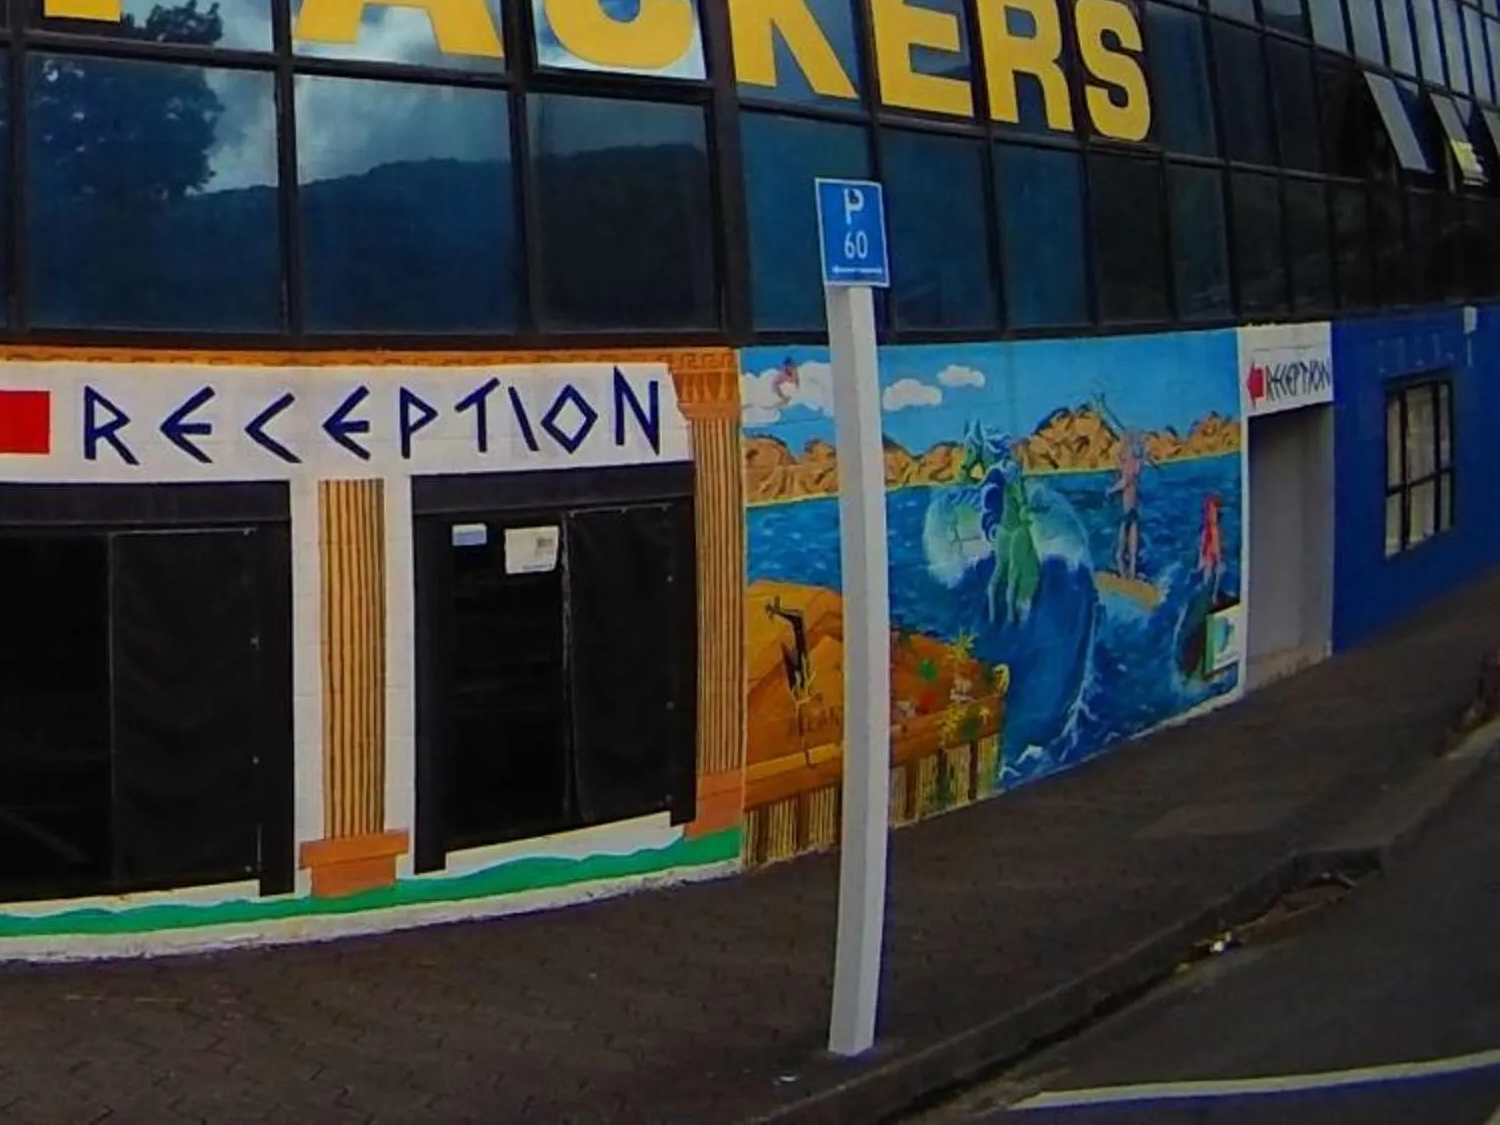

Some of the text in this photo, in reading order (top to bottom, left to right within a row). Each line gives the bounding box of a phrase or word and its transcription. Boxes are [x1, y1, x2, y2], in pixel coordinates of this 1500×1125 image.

[843, 188, 865, 225] P
[844, 230, 869, 260] 60
[1266, 359, 1331, 401] RECEPTION
[82, 365, 663, 466] RECEPTION
